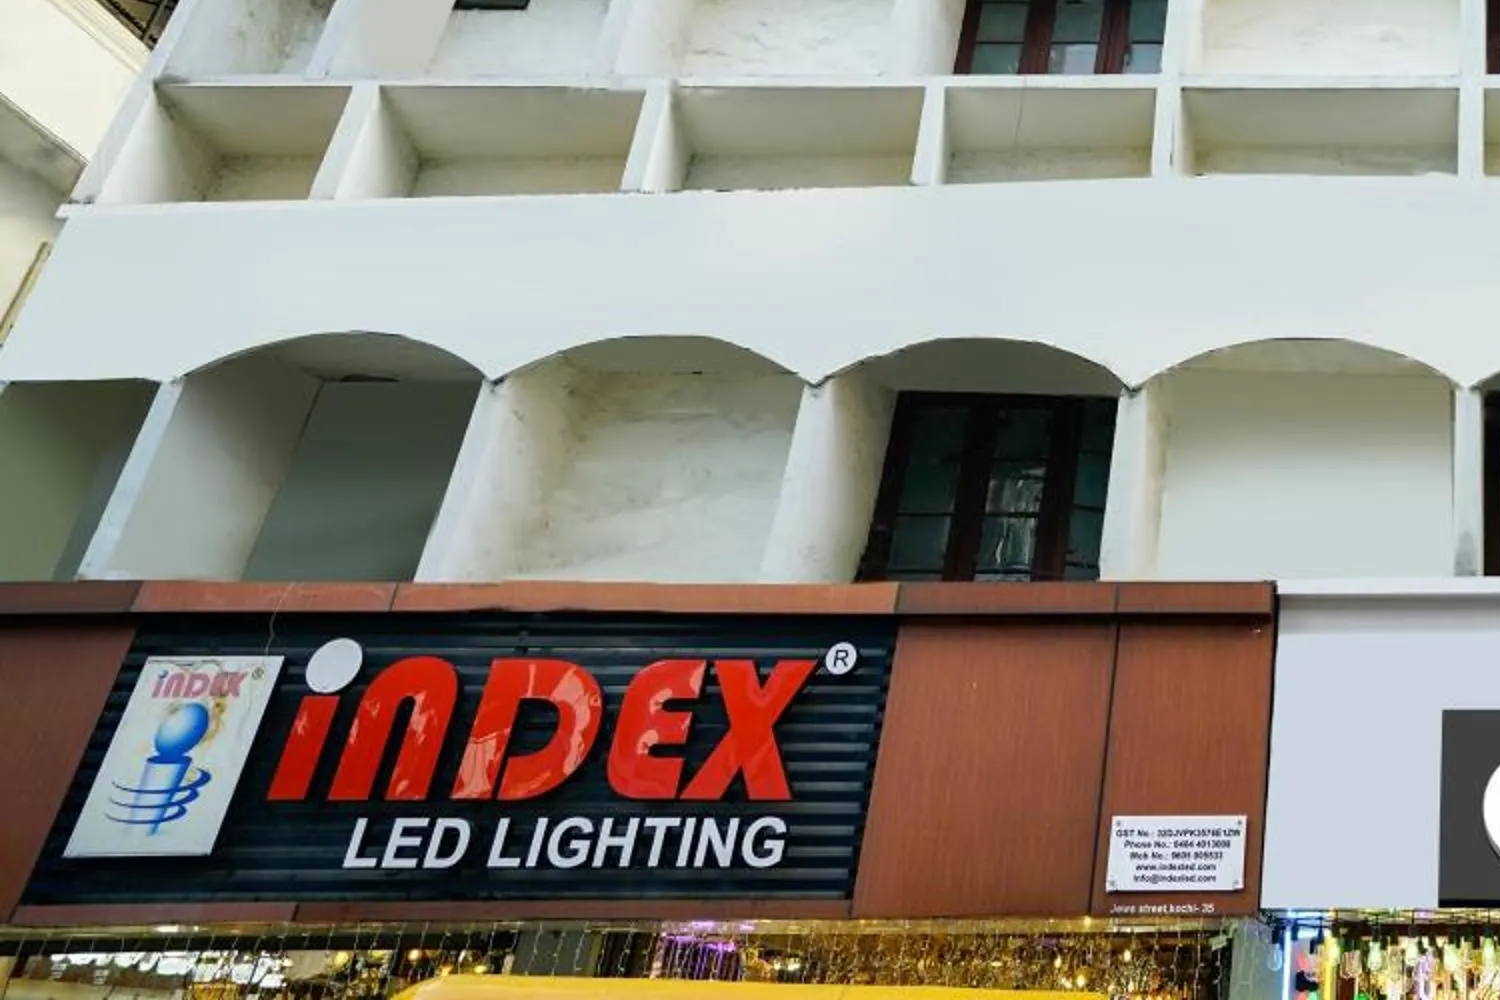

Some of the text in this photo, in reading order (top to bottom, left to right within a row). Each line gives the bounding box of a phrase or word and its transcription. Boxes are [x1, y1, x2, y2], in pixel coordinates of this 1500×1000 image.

[342, 816, 787, 868] LED LIGHTING
[1123, 840, 1152, 849] Phone
